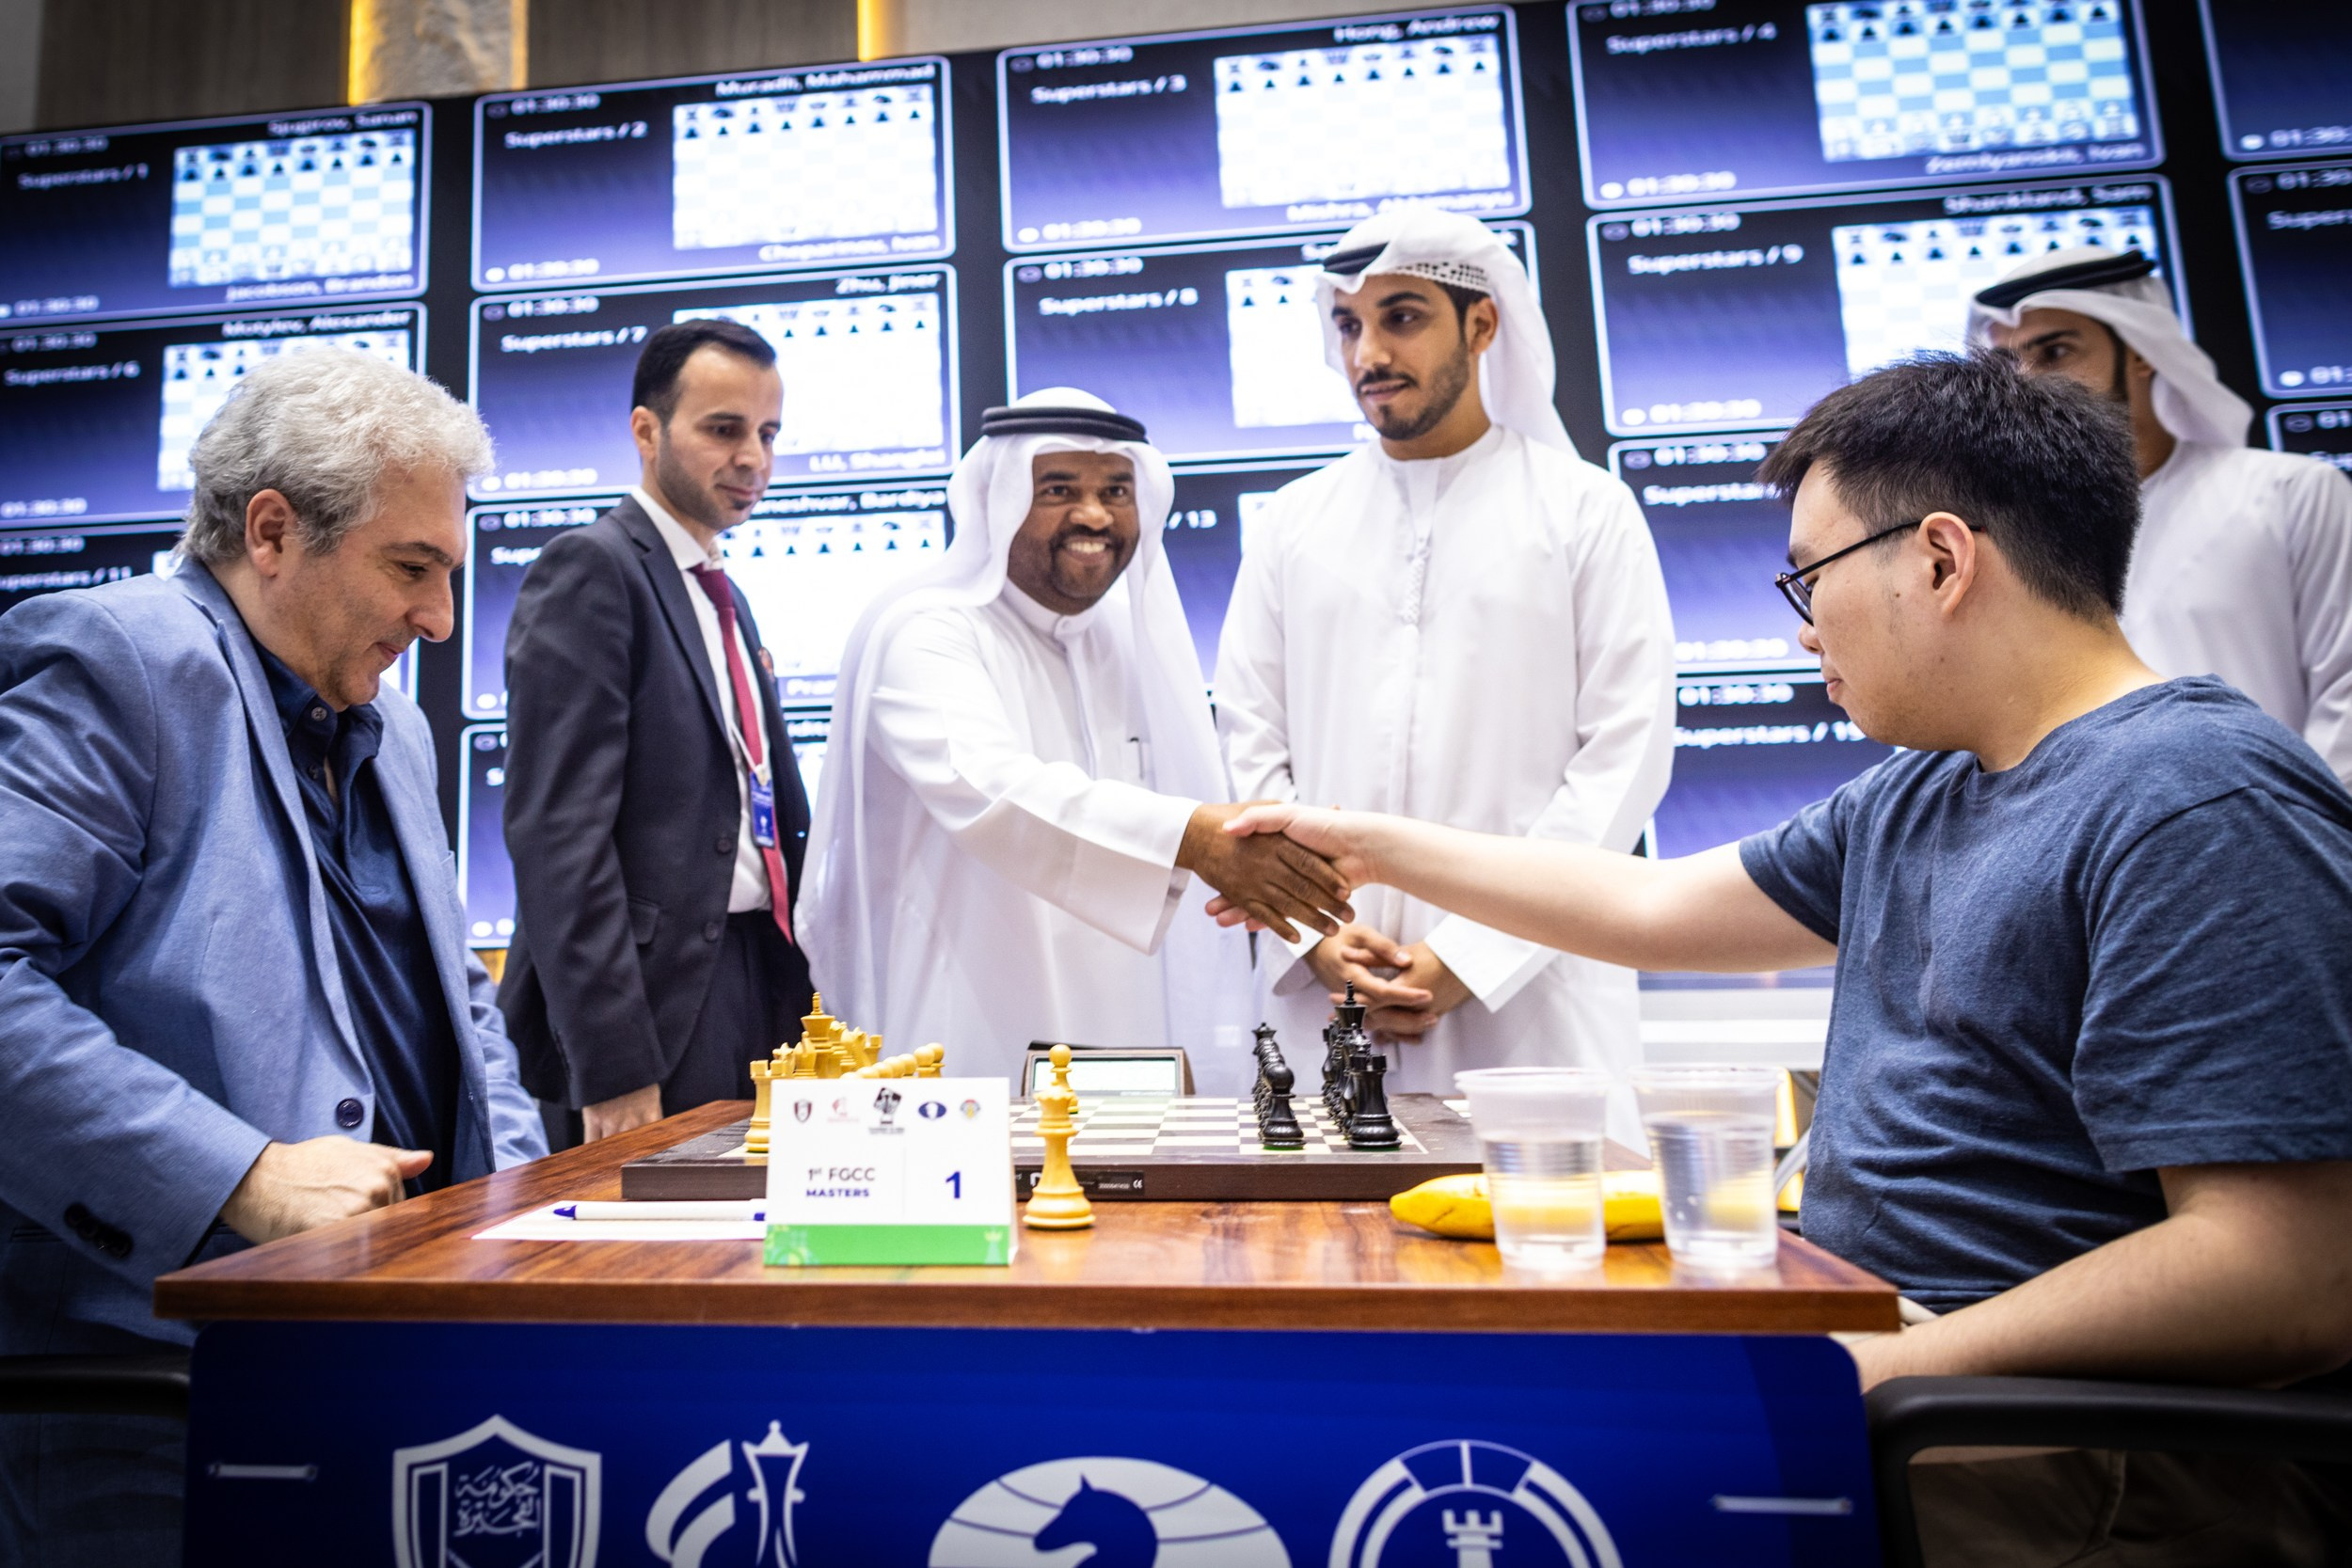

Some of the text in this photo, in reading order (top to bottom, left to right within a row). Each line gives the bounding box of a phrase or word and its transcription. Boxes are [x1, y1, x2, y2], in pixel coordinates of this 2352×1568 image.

[829, 1167, 876, 1181] FGCC
[945, 1171, 961, 1199] 1
[805, 1189, 870, 1197] MASTERS
